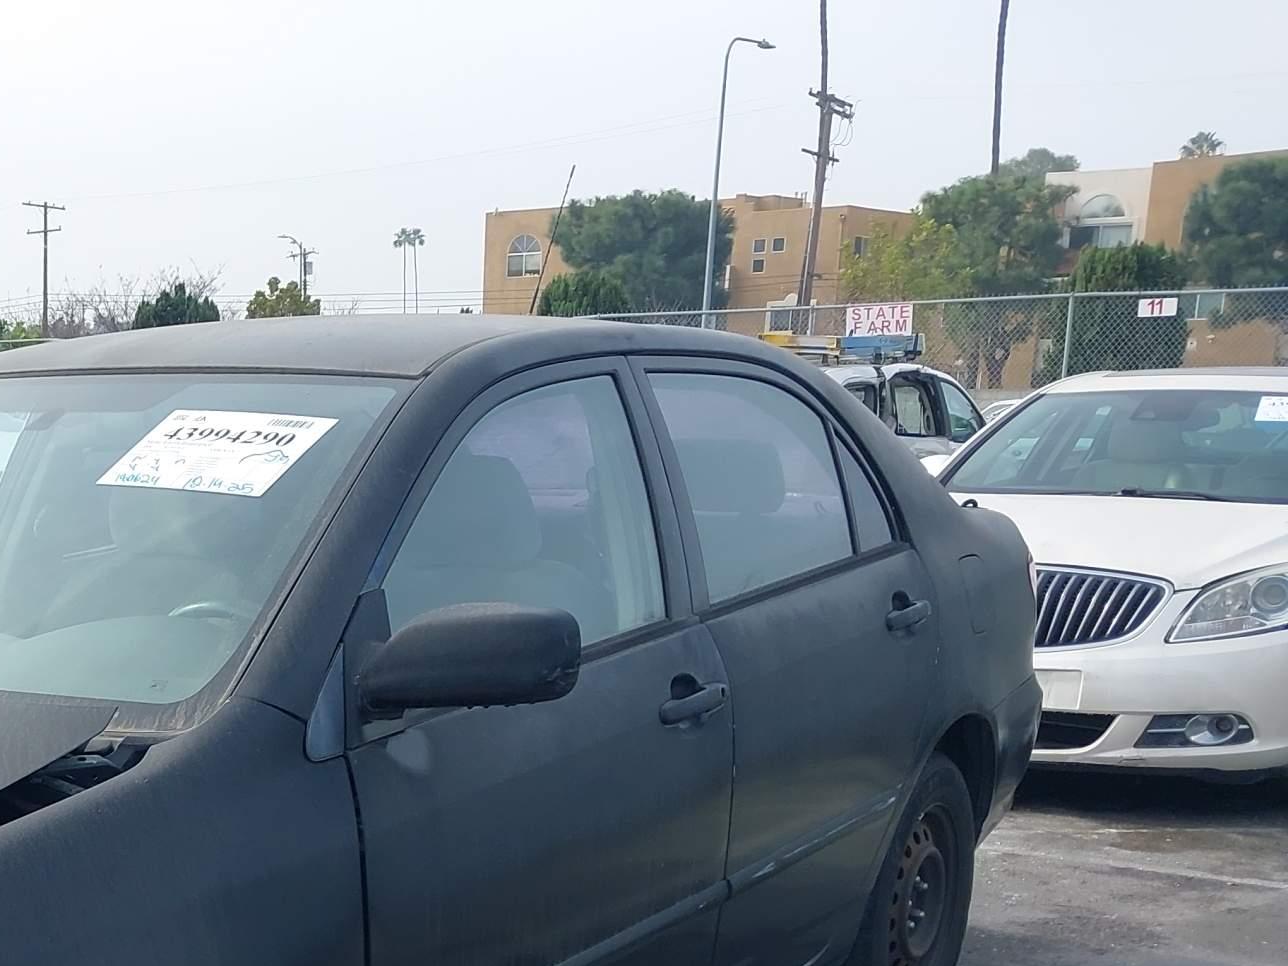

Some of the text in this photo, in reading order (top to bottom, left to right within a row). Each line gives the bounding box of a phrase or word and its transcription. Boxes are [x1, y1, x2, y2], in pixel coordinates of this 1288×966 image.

[851, 306, 910, 321] STATE
[1147, 299, 1164, 315] 11
[853, 319, 907, 334] FARM
[163, 426, 297, 447] 43994290
